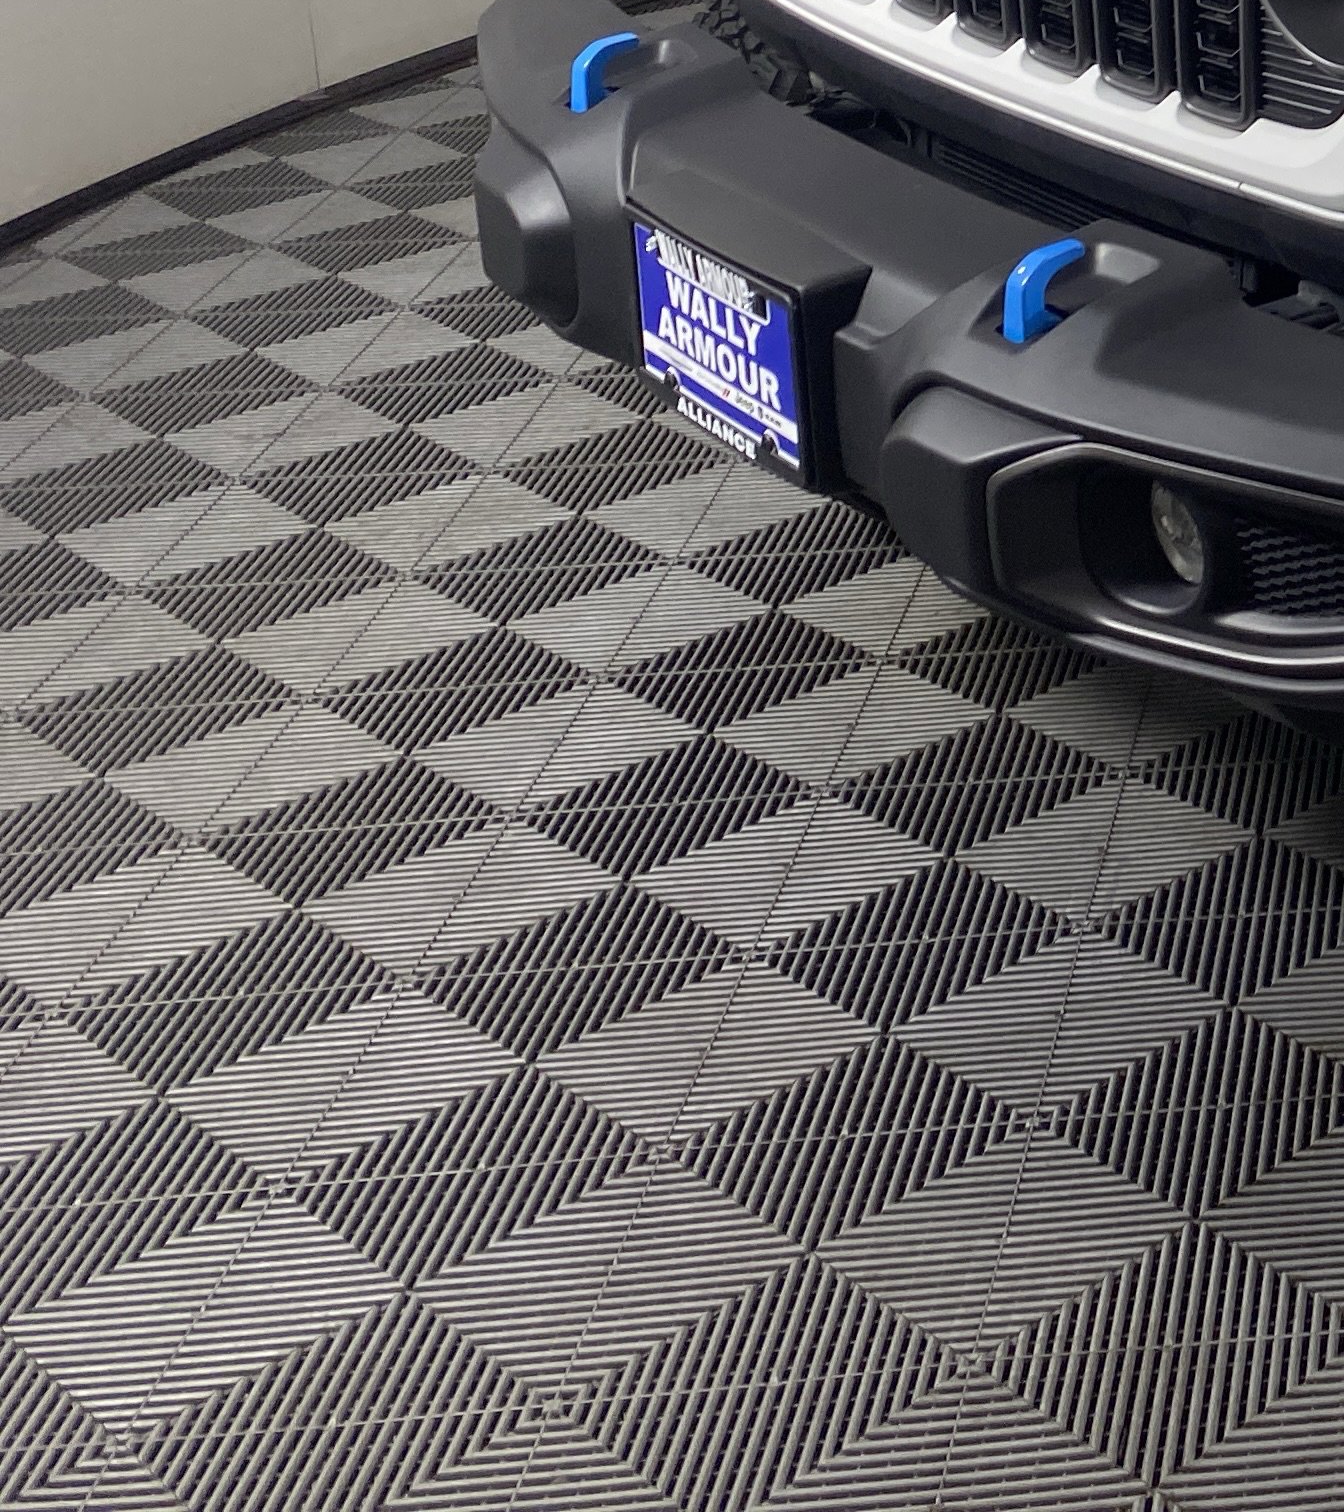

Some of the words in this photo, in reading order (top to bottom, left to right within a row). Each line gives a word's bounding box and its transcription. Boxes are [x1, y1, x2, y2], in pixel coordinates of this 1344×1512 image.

[665, 269, 762, 356] WALLY
[657, 305, 782, 411] ARMOUR
[676, 395, 757, 460] ALLIANCE
